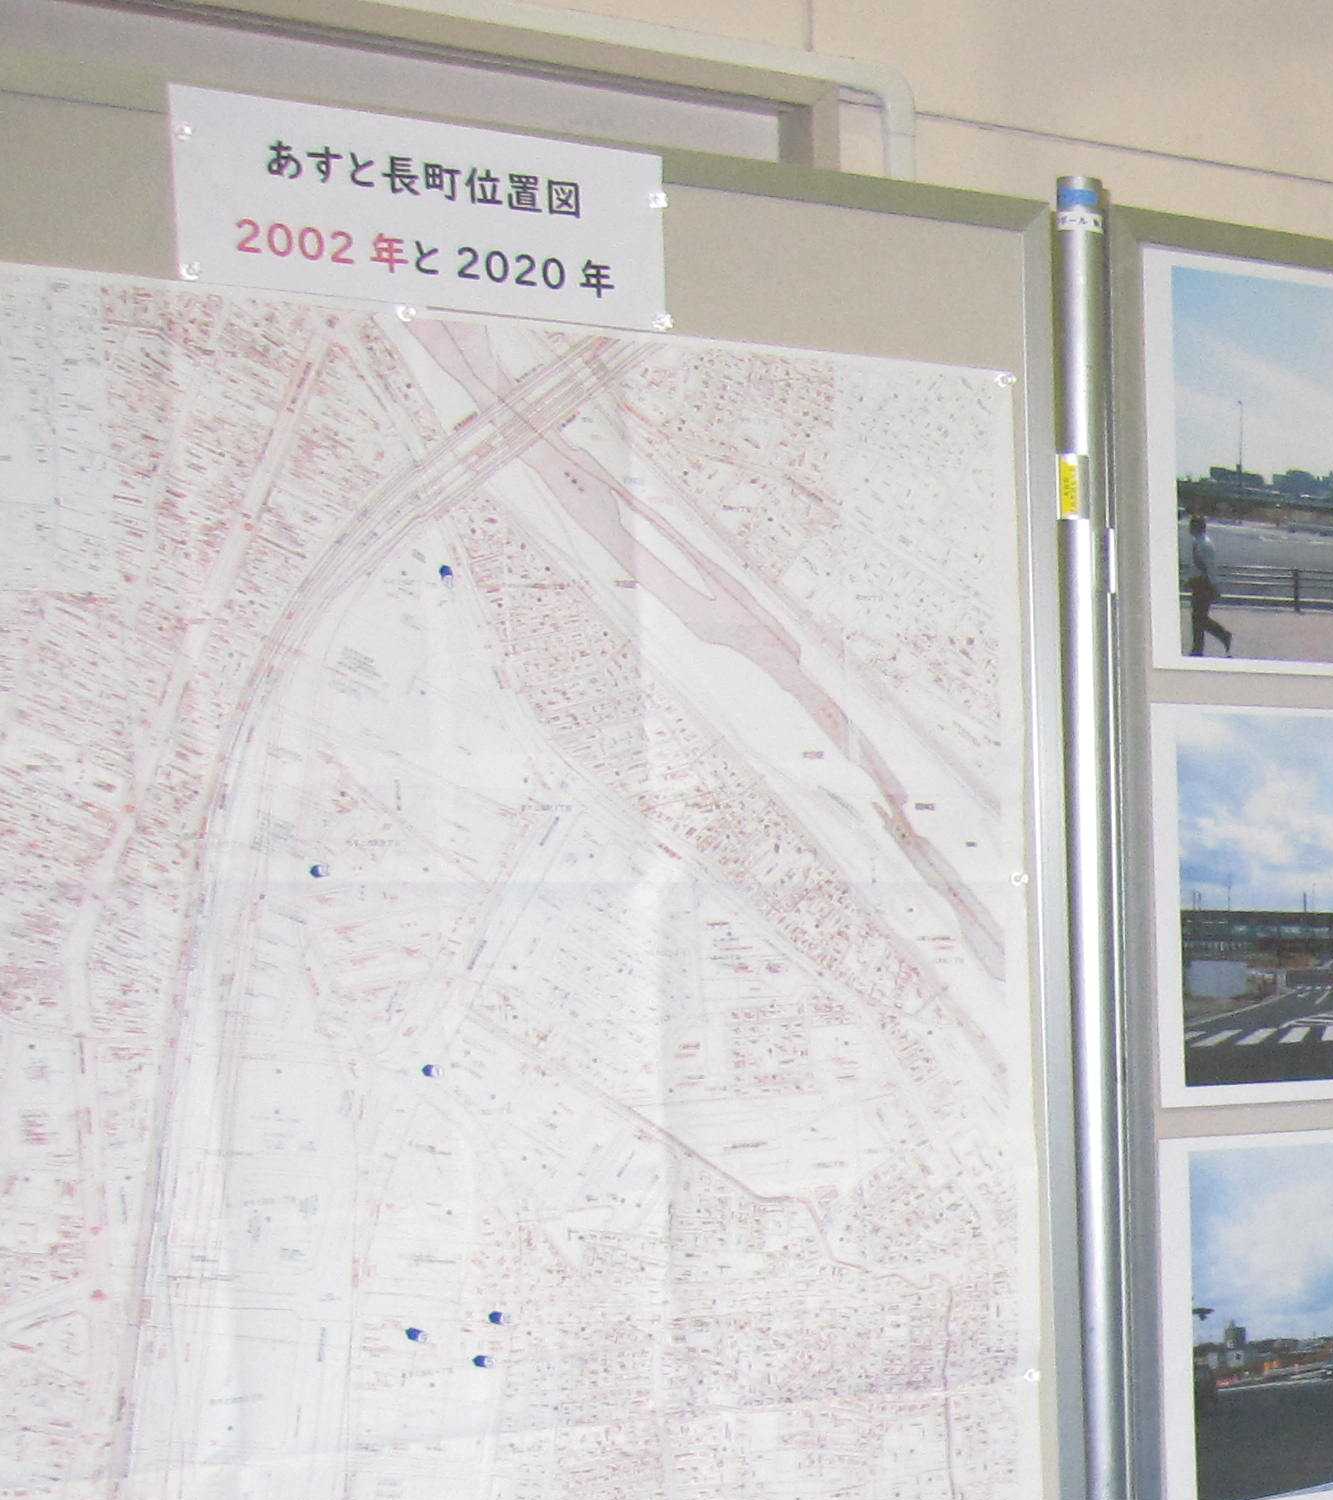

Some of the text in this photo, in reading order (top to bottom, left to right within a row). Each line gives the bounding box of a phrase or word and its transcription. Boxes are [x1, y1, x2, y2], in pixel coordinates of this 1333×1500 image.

[267, 140, 581, 219] あすと長町位置図
[235, 218, 615, 299] 2002年と2020年
